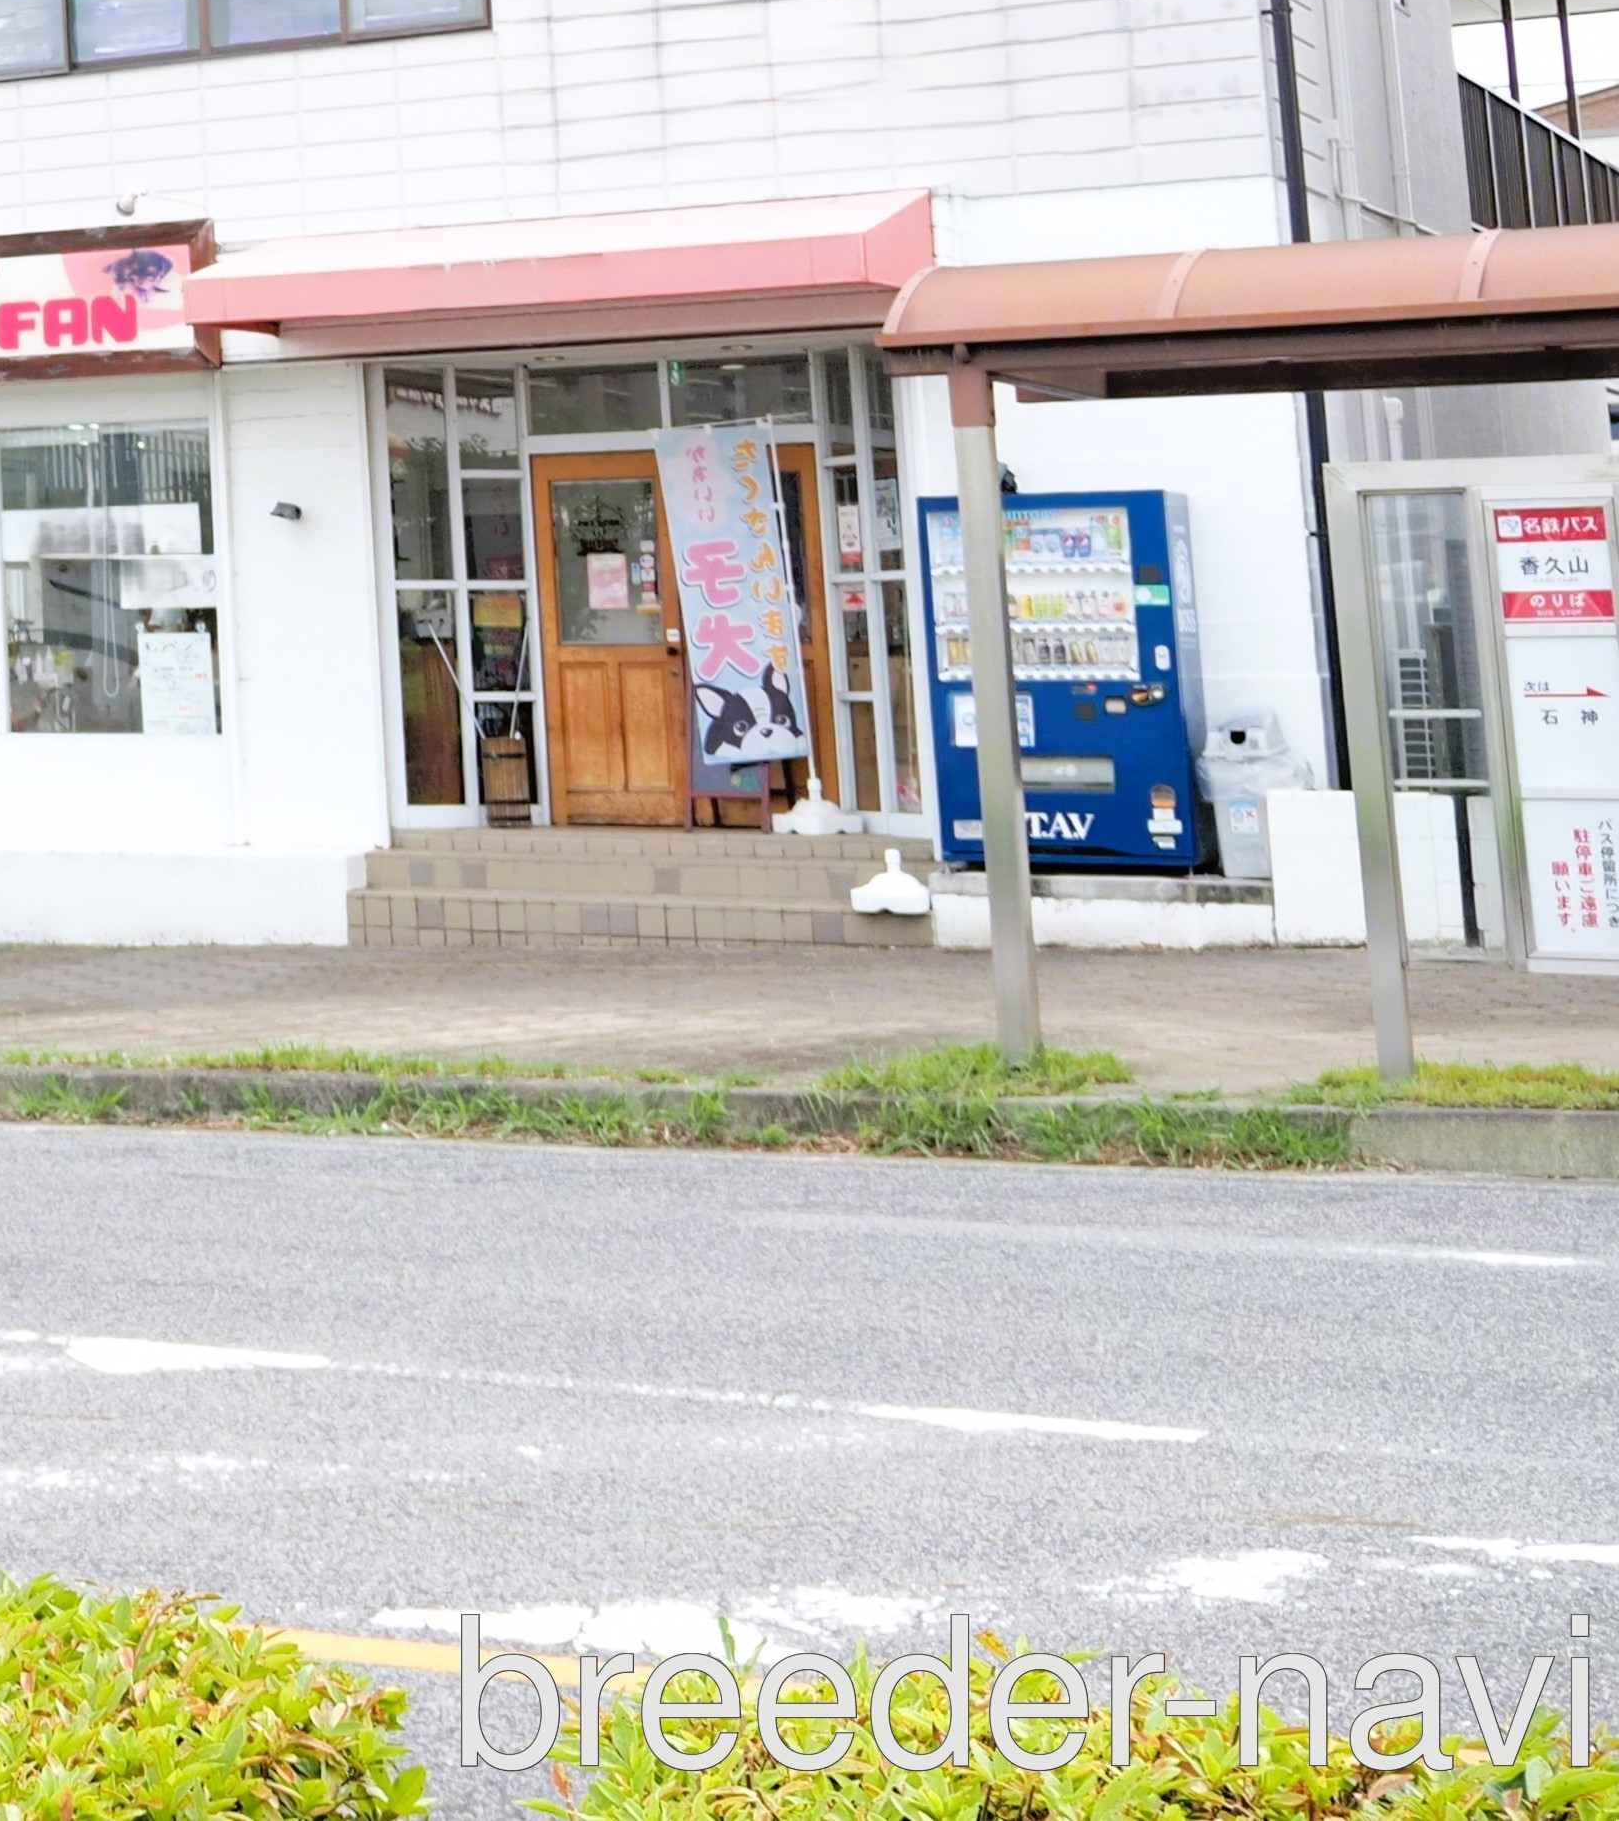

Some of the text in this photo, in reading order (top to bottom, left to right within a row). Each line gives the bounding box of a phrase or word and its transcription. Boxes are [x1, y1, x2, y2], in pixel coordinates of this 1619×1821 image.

[1523, 516, 1599, 536] 名鉄バス
[1519, 555, 1590, 576] 香久山
[1529, 592, 1586, 608] のりば
[1524, 681, 1550, 693] 次は
